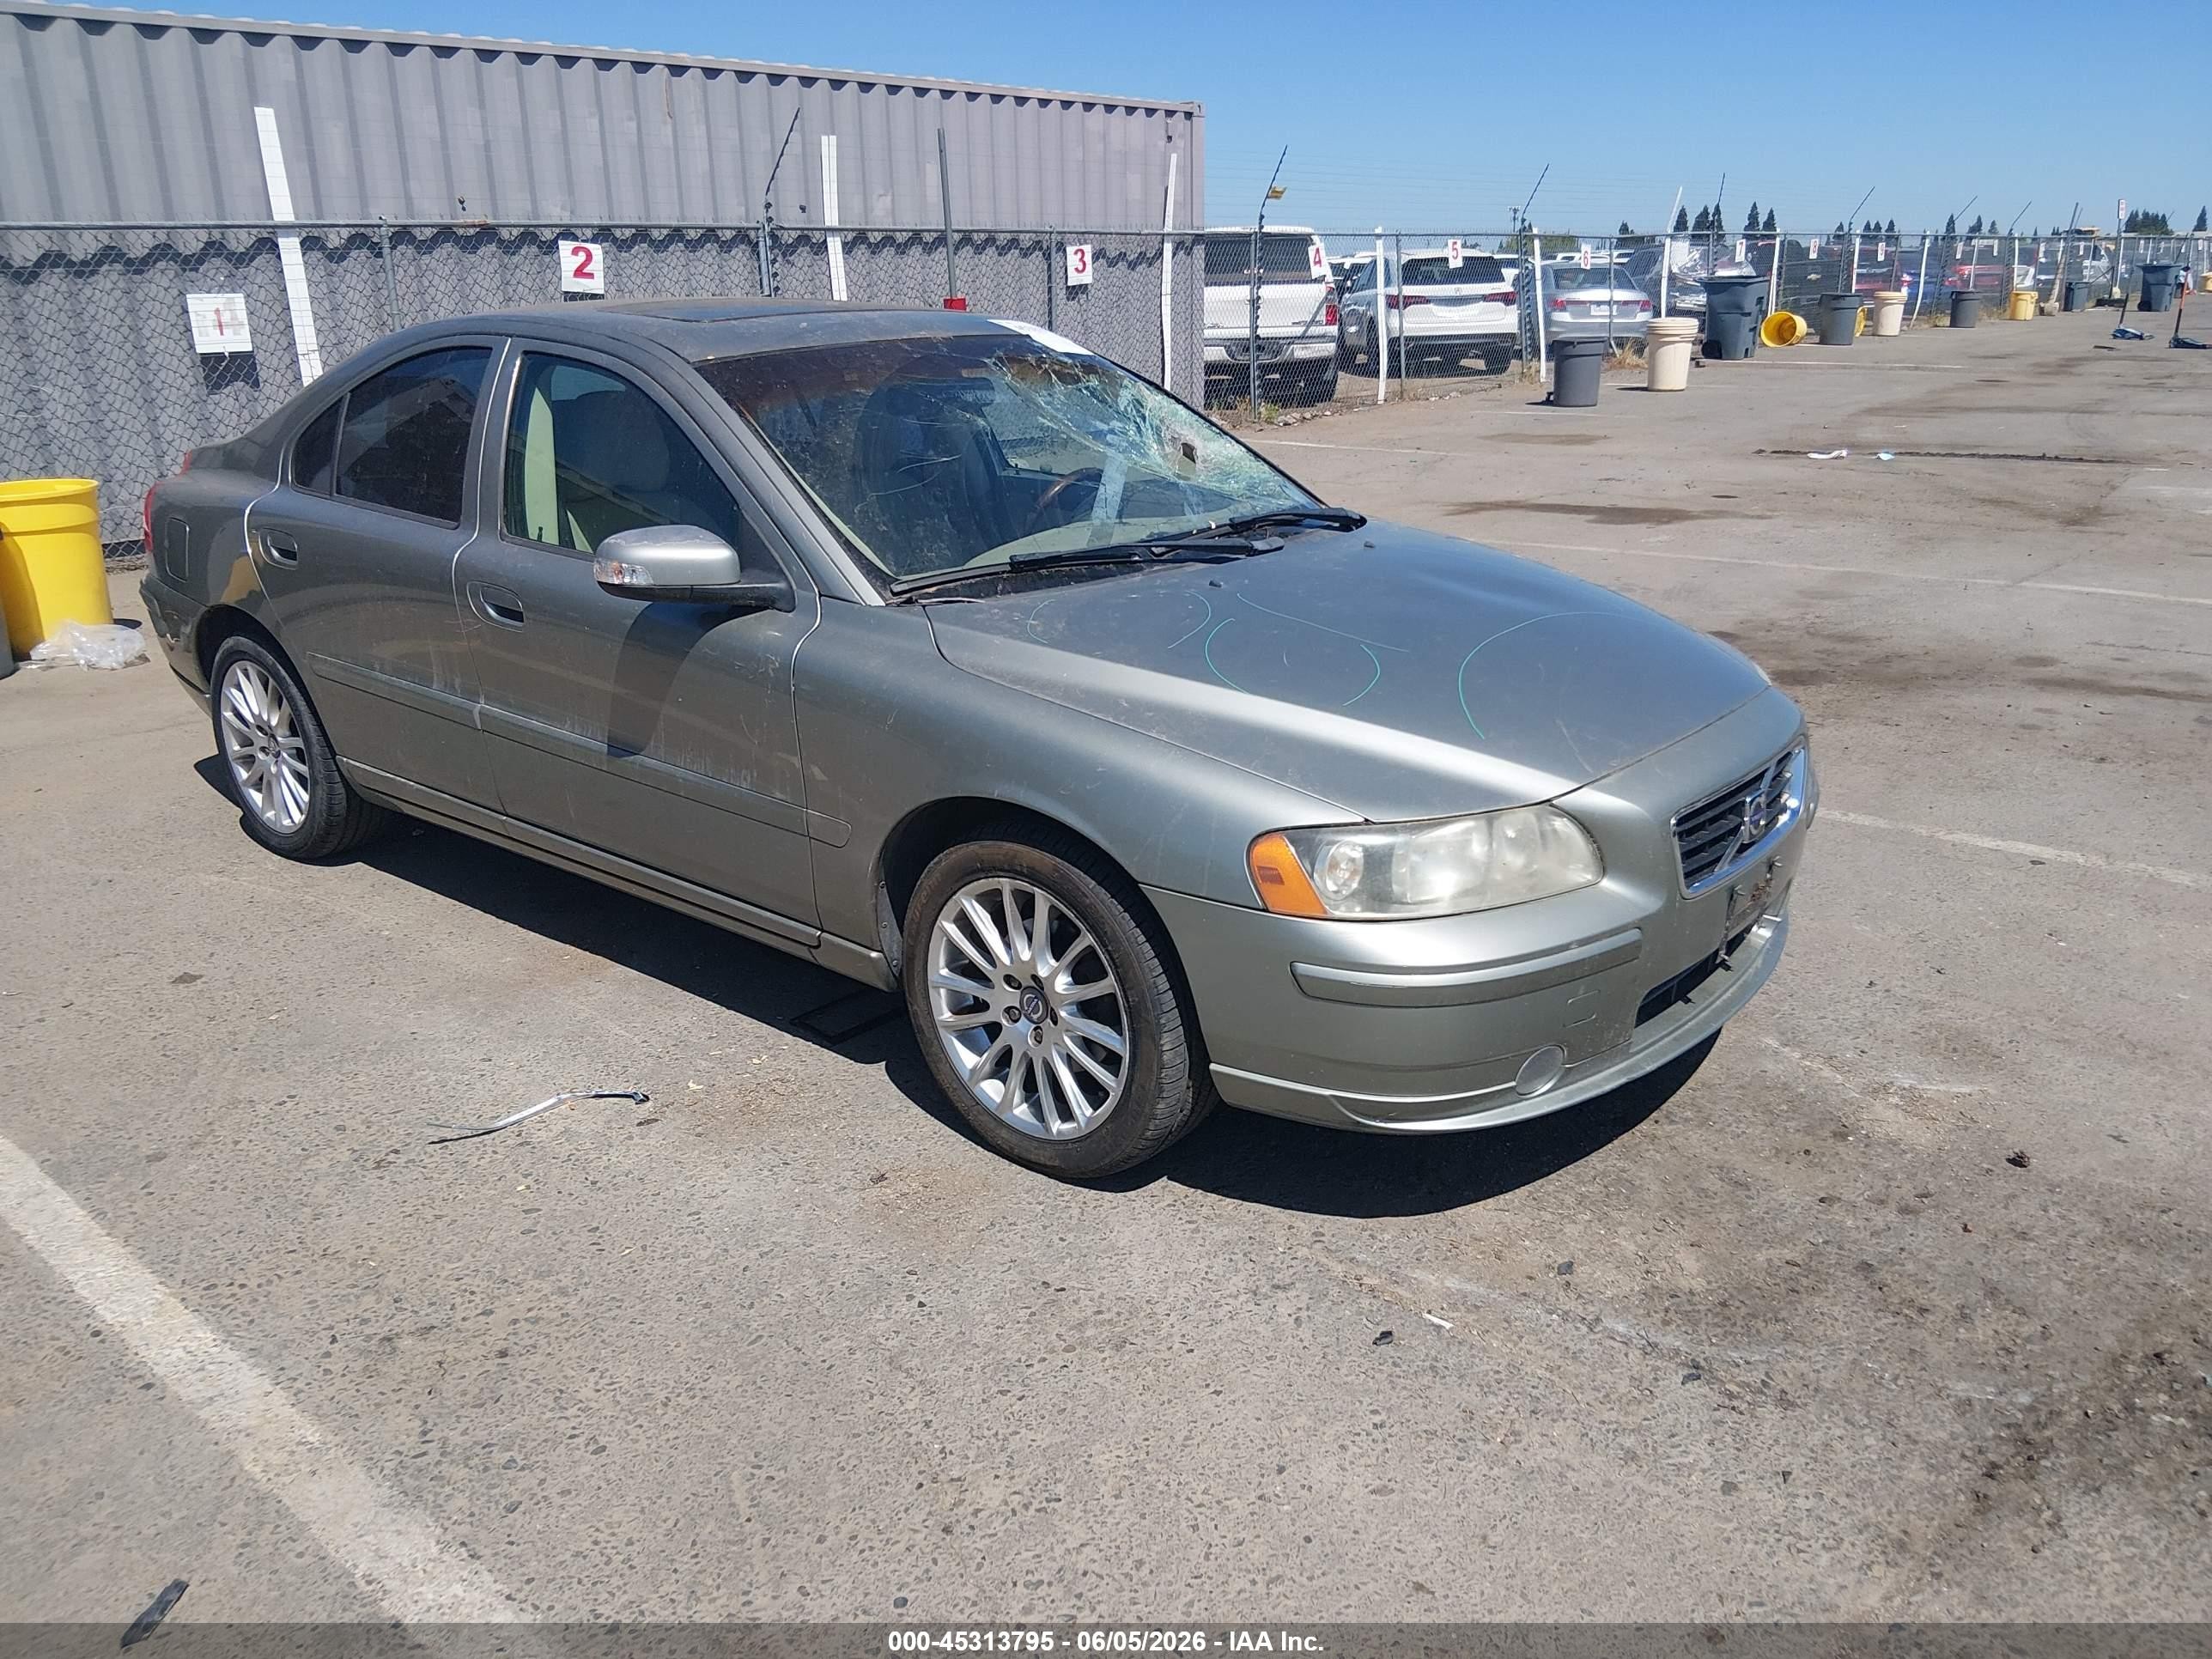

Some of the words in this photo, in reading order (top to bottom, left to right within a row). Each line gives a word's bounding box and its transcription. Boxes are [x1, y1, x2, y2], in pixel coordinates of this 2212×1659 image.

[1314, 246, 1322, 268] 4
[1452, 240, 1459, 260] 5
[1739, 240, 1744, 257] 7
[1813, 240, 1817, 254] 8
[571, 246, 595, 280] 2
[1073, 248, 1086, 274] 3
[1583, 250, 1589, 267] 6
